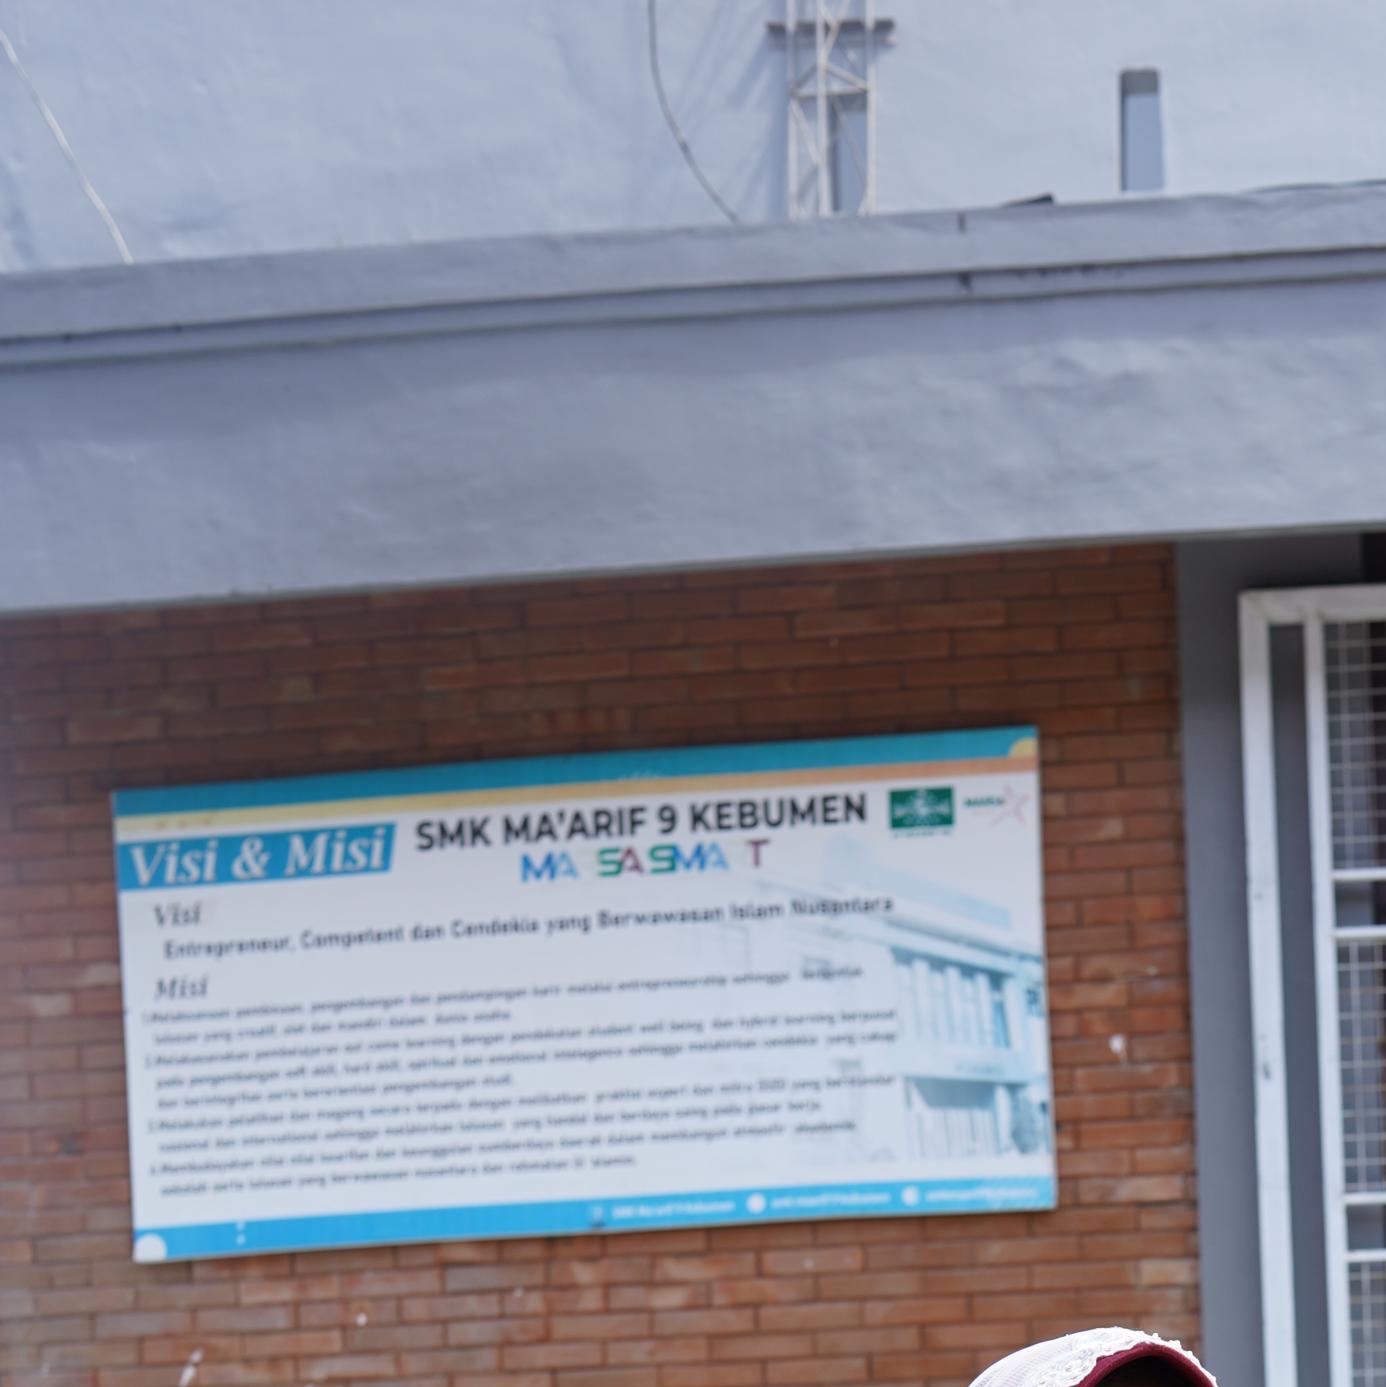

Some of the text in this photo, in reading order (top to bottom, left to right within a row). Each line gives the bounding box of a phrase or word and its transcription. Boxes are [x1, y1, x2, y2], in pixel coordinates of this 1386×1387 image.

[415, 793, 867, 851] SMK MA'ARIF 9 KEBUMEN
[129, 826, 387, 887] Visi & Misi
[153, 902, 204, 928] Visi
[154, 975, 210, 1001] Misi
